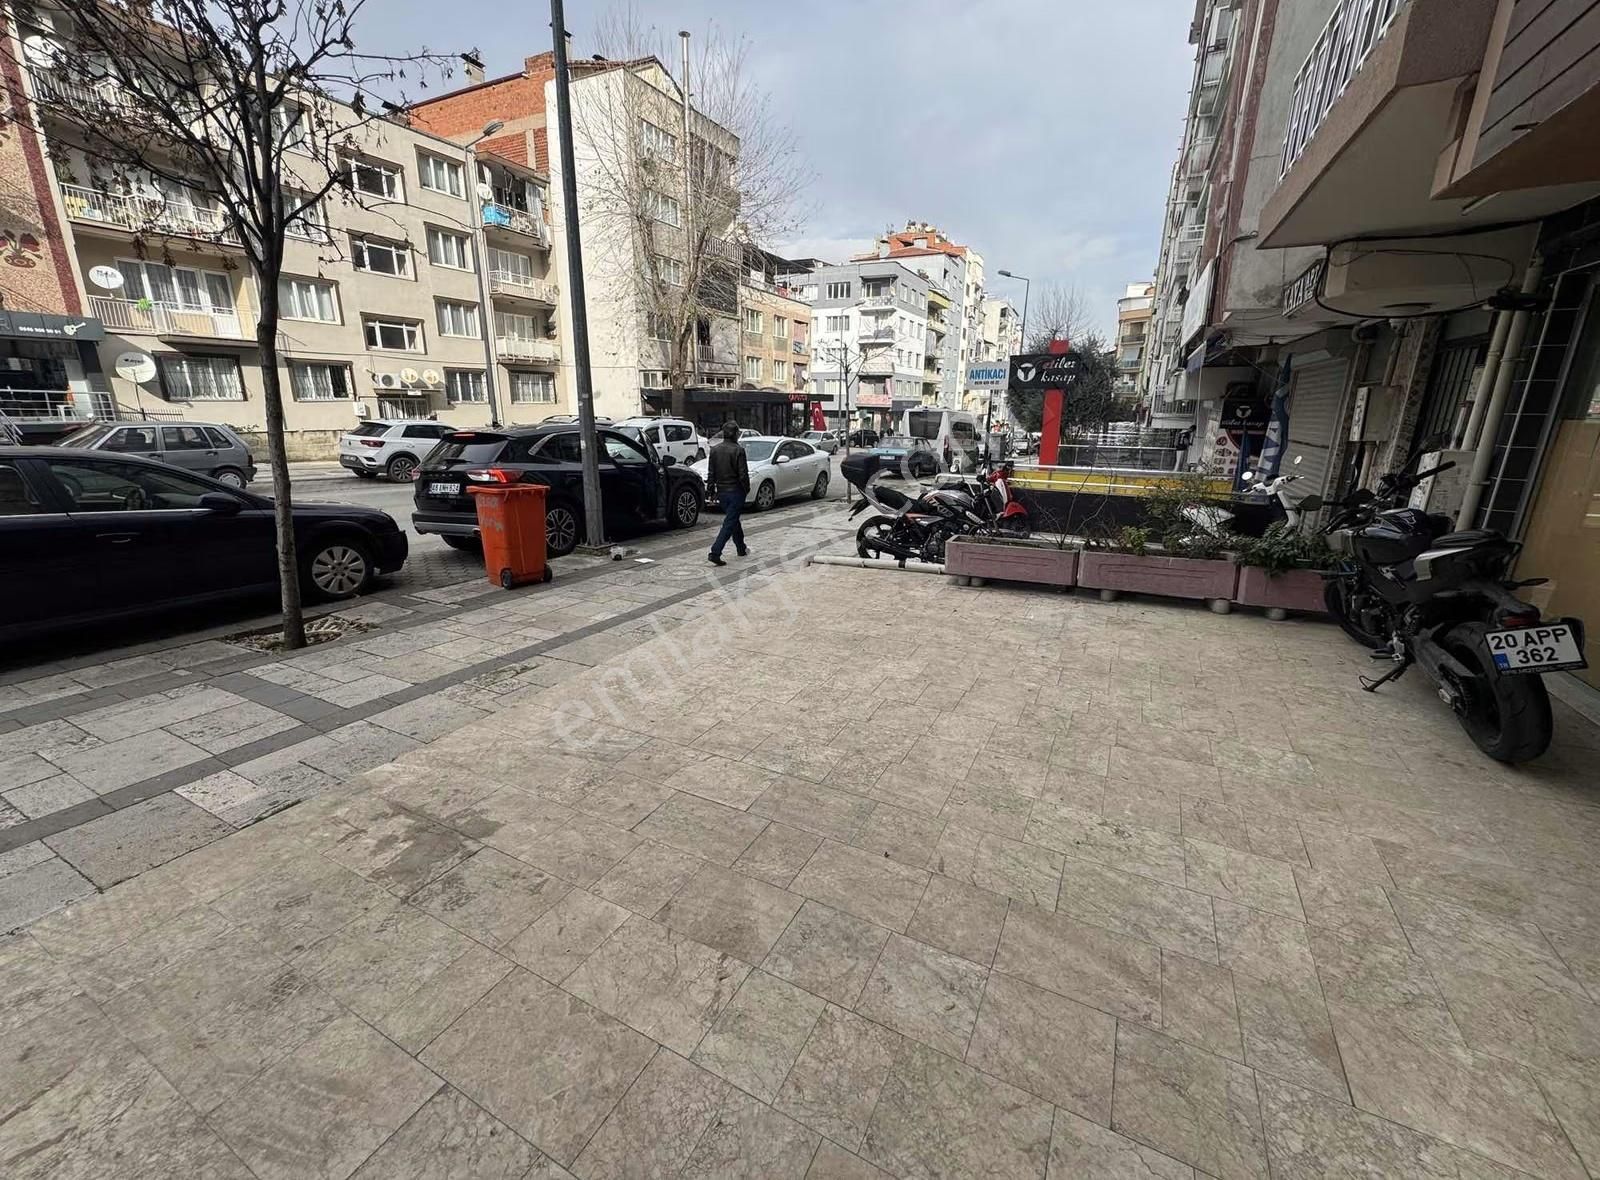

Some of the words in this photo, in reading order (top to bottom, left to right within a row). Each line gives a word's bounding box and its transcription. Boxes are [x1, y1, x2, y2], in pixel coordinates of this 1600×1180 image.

[969, 367, 1006, 380] ANTİKACI
[1040, 370, 1076, 385] kasap
[1490, 633, 1518, 650] 20
[1524, 628, 1567, 647] APP
[1516, 646, 1559, 664] 362
